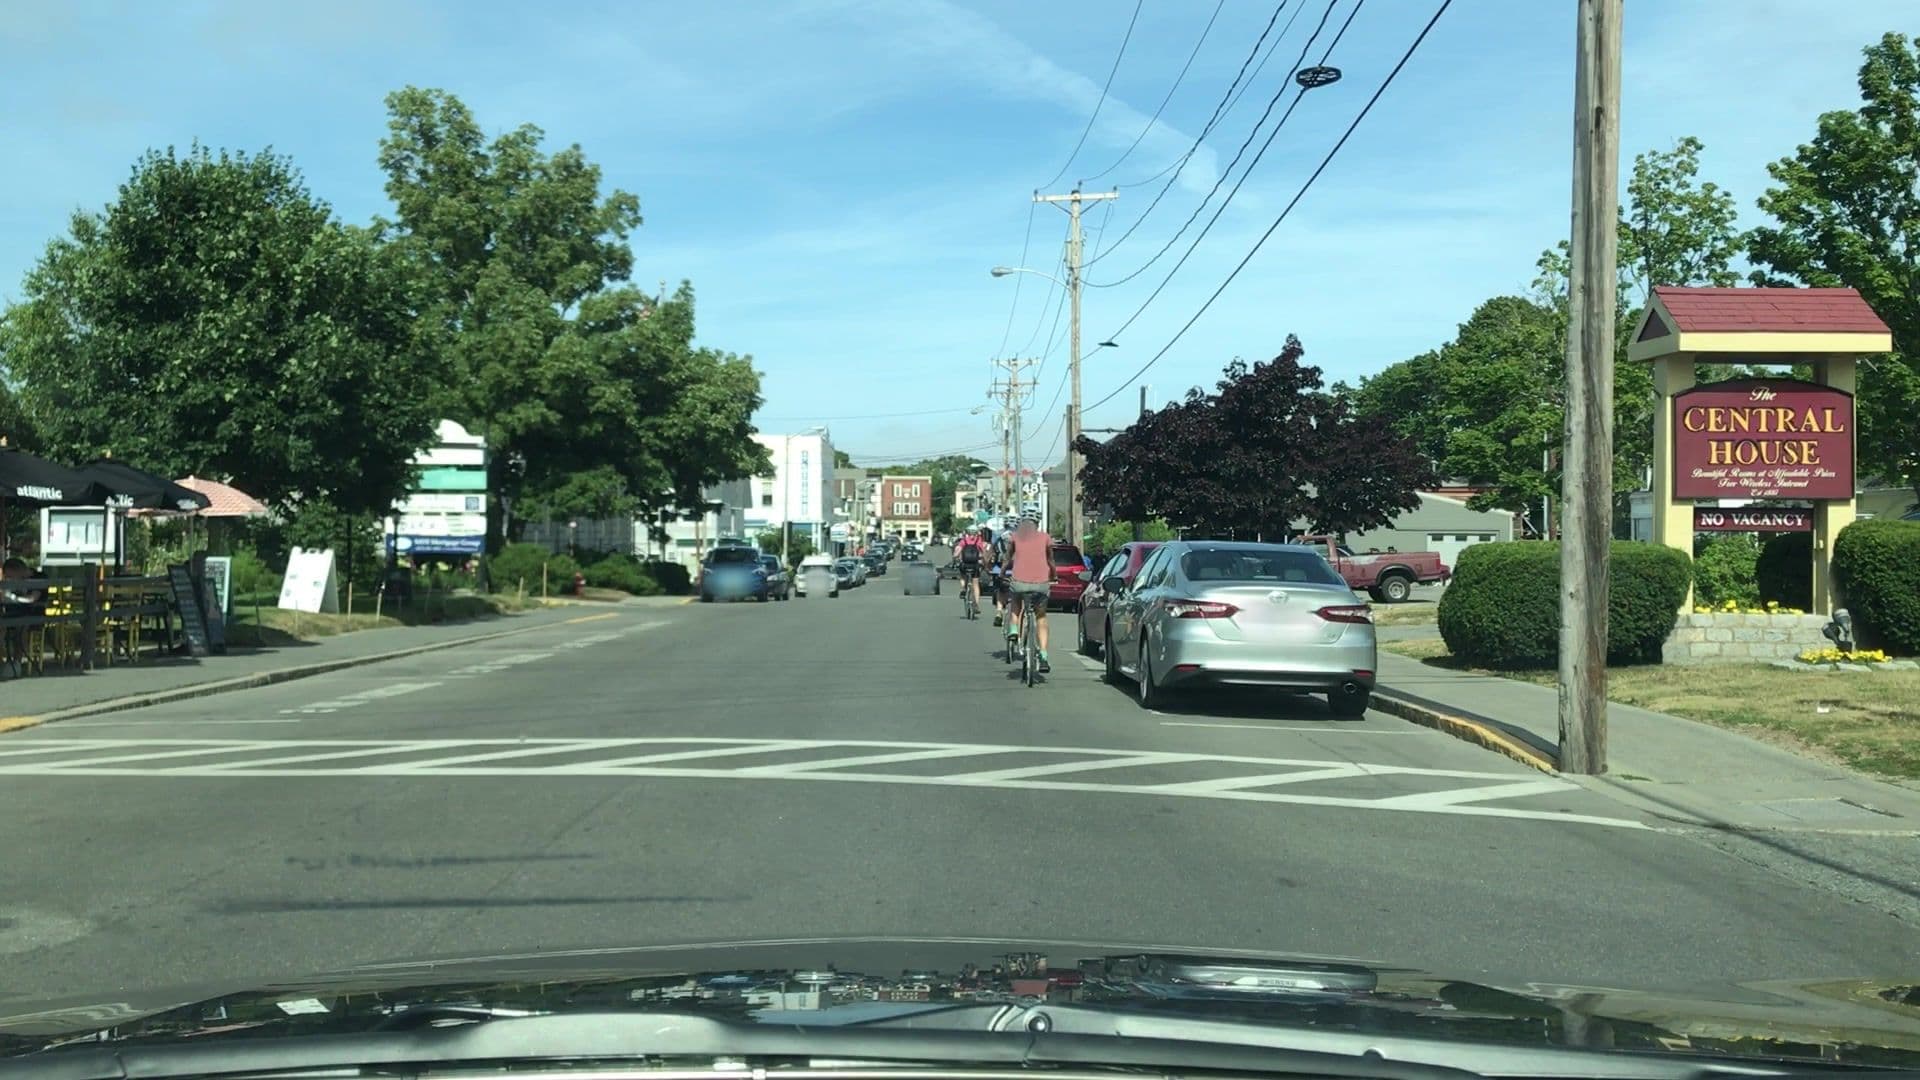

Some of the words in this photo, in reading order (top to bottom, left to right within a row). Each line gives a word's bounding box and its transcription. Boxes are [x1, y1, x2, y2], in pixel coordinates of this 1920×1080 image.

[1749, 386, 1777, 401] The
[1684, 407, 1845, 433] CENTRAL
[1708, 440, 1820, 465] HOUSE
[1691, 468, 1728, 480] Beautiful
[1729, 468, 1757, 478] Rooms
[16, 484, 63, 500] atlantic
[1700, 513, 1725, 526] NO
[1731, 513, 1805, 526] VACANCY
